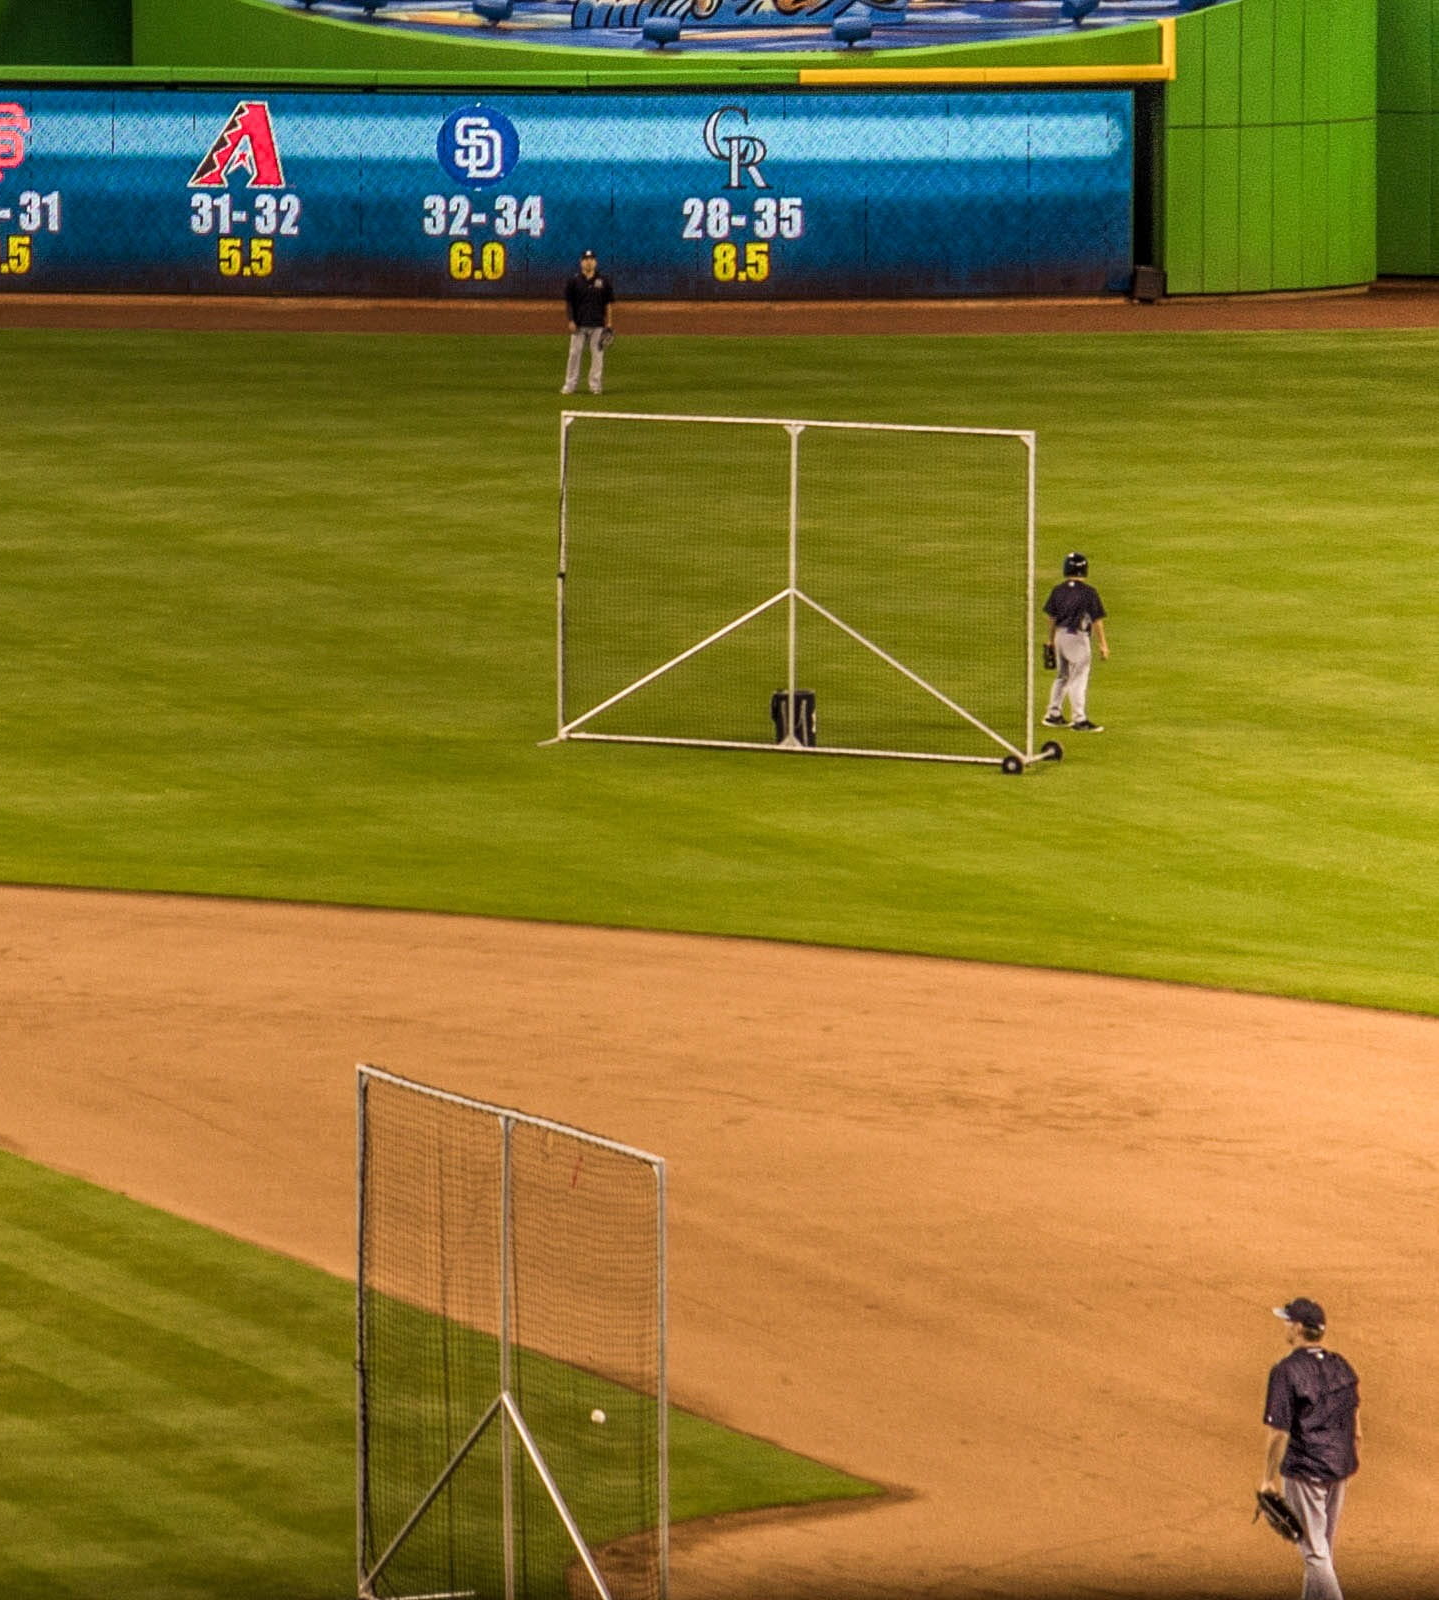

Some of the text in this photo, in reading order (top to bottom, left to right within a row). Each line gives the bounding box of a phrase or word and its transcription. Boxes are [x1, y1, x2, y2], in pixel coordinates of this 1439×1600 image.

[218, 238, 273, 277] 5.5
[449, 242, 505, 281] 6.0
[713, 243, 771, 282] 8.5
